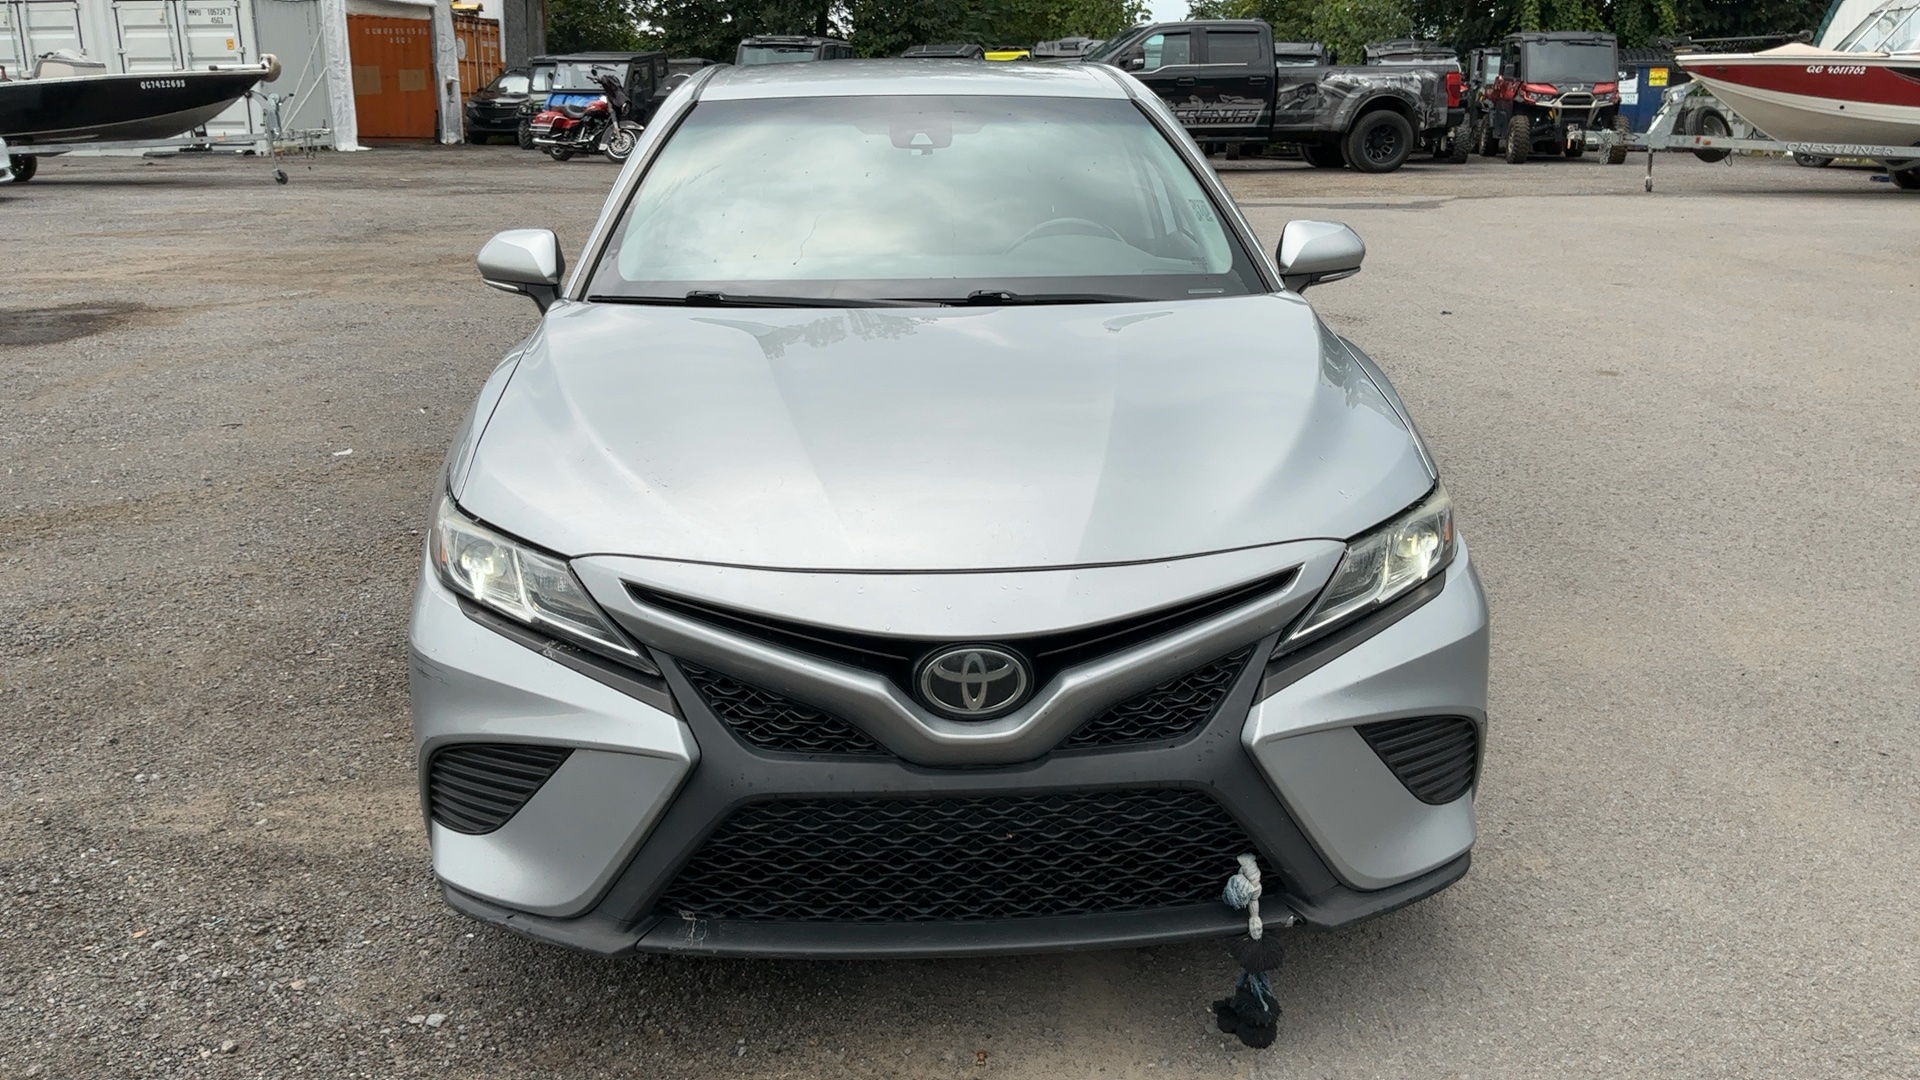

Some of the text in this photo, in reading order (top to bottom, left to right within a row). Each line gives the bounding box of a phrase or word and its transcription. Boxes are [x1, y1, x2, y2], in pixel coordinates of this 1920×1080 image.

[1806, 65, 1867, 75] QC 4611762
[1786, 142, 1894, 156] CRESTLINER
